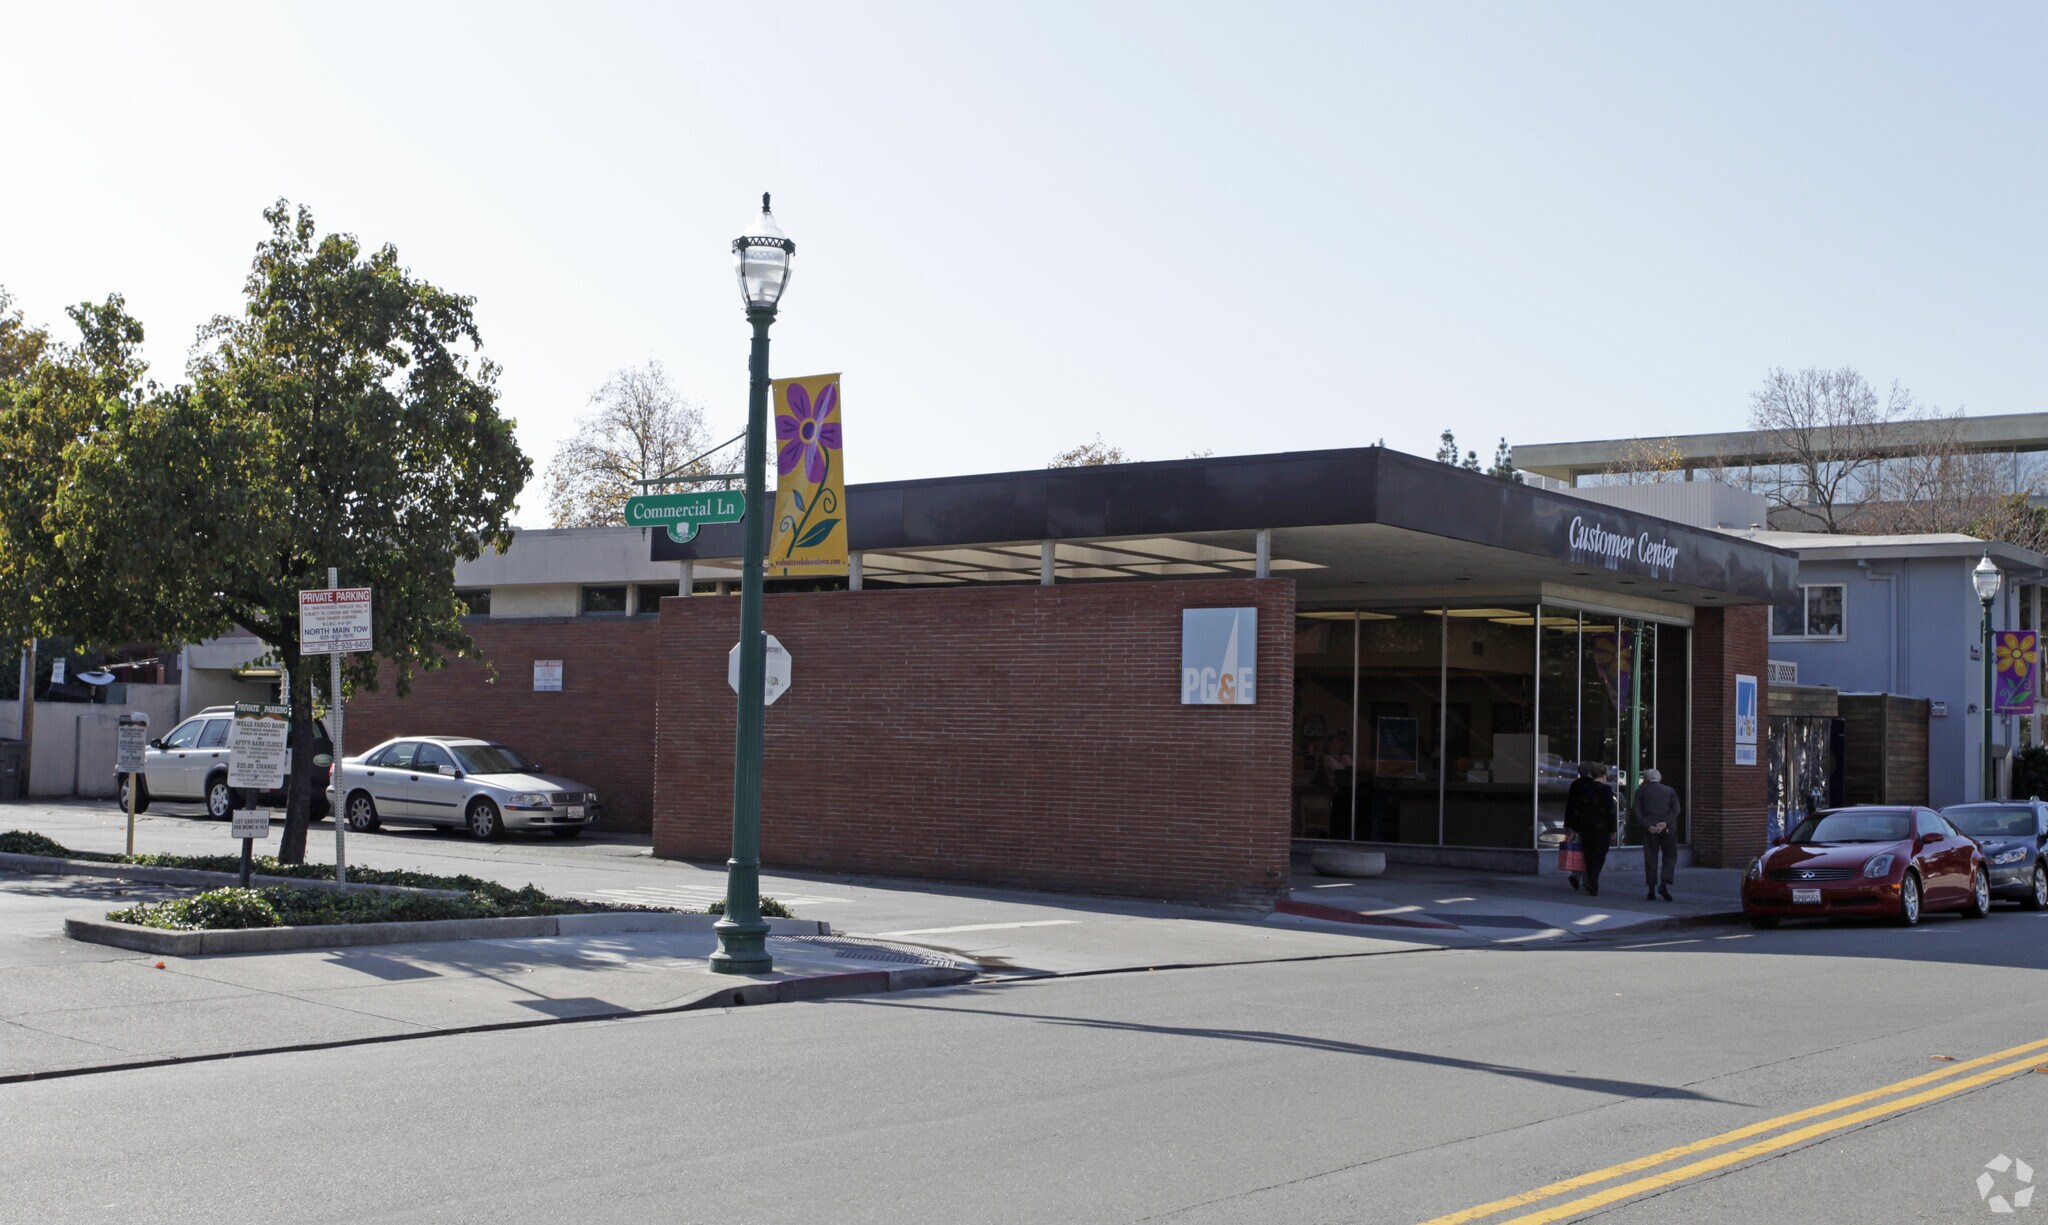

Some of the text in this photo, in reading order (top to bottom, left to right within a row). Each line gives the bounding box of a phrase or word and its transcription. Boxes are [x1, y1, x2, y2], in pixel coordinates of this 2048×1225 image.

[634, 498, 734, 520] Commercial Ln
[1569, 516, 1678, 568] Customer Center
[302, 590, 370, 603] PRIVATE PARKING
[1182, 666, 1252, 704] PG&E
[236, 704, 260, 712] PRIVATE
